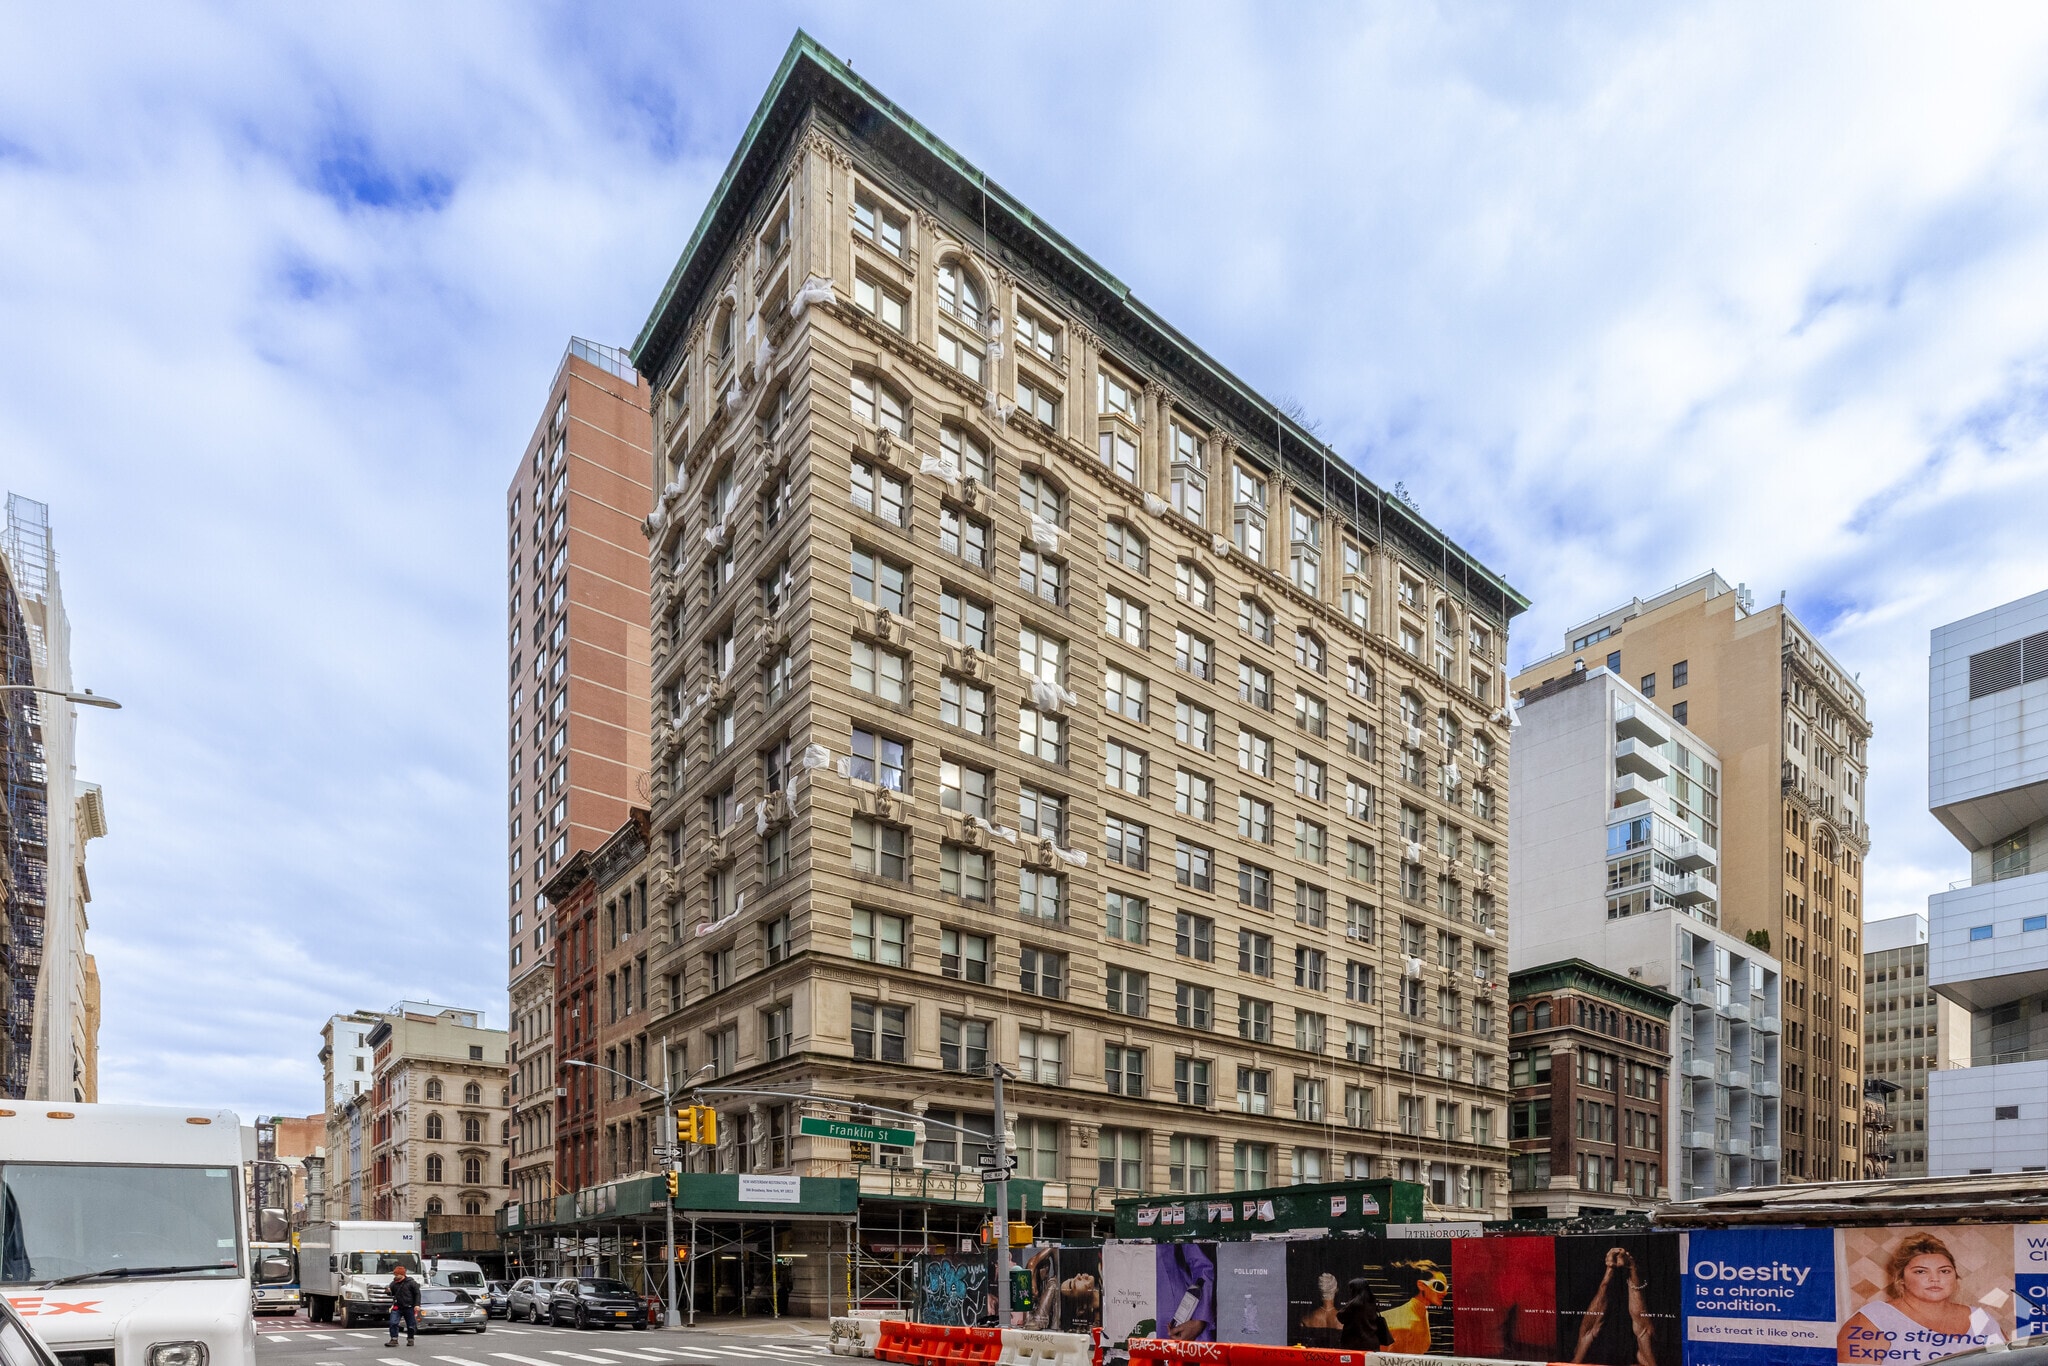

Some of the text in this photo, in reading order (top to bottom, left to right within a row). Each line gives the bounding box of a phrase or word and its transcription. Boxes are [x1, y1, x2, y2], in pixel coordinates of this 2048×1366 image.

[829, 1124, 889, 1140] Franklin St
[894, 1177, 968, 1191] BERNARD
[1694, 1261, 1811, 1286] Obesity
[1118, 1288, 1126, 1296] So
[1696, 1284, 1795, 1298] is a chronic
[1696, 1299, 1782, 1312] condition.
[1696, 1325, 1819, 1339] Let's treat it like one.
[1847, 1326, 1994, 1347] Zero stigma.
[1849, 1344, 1921, 1361] Expert
